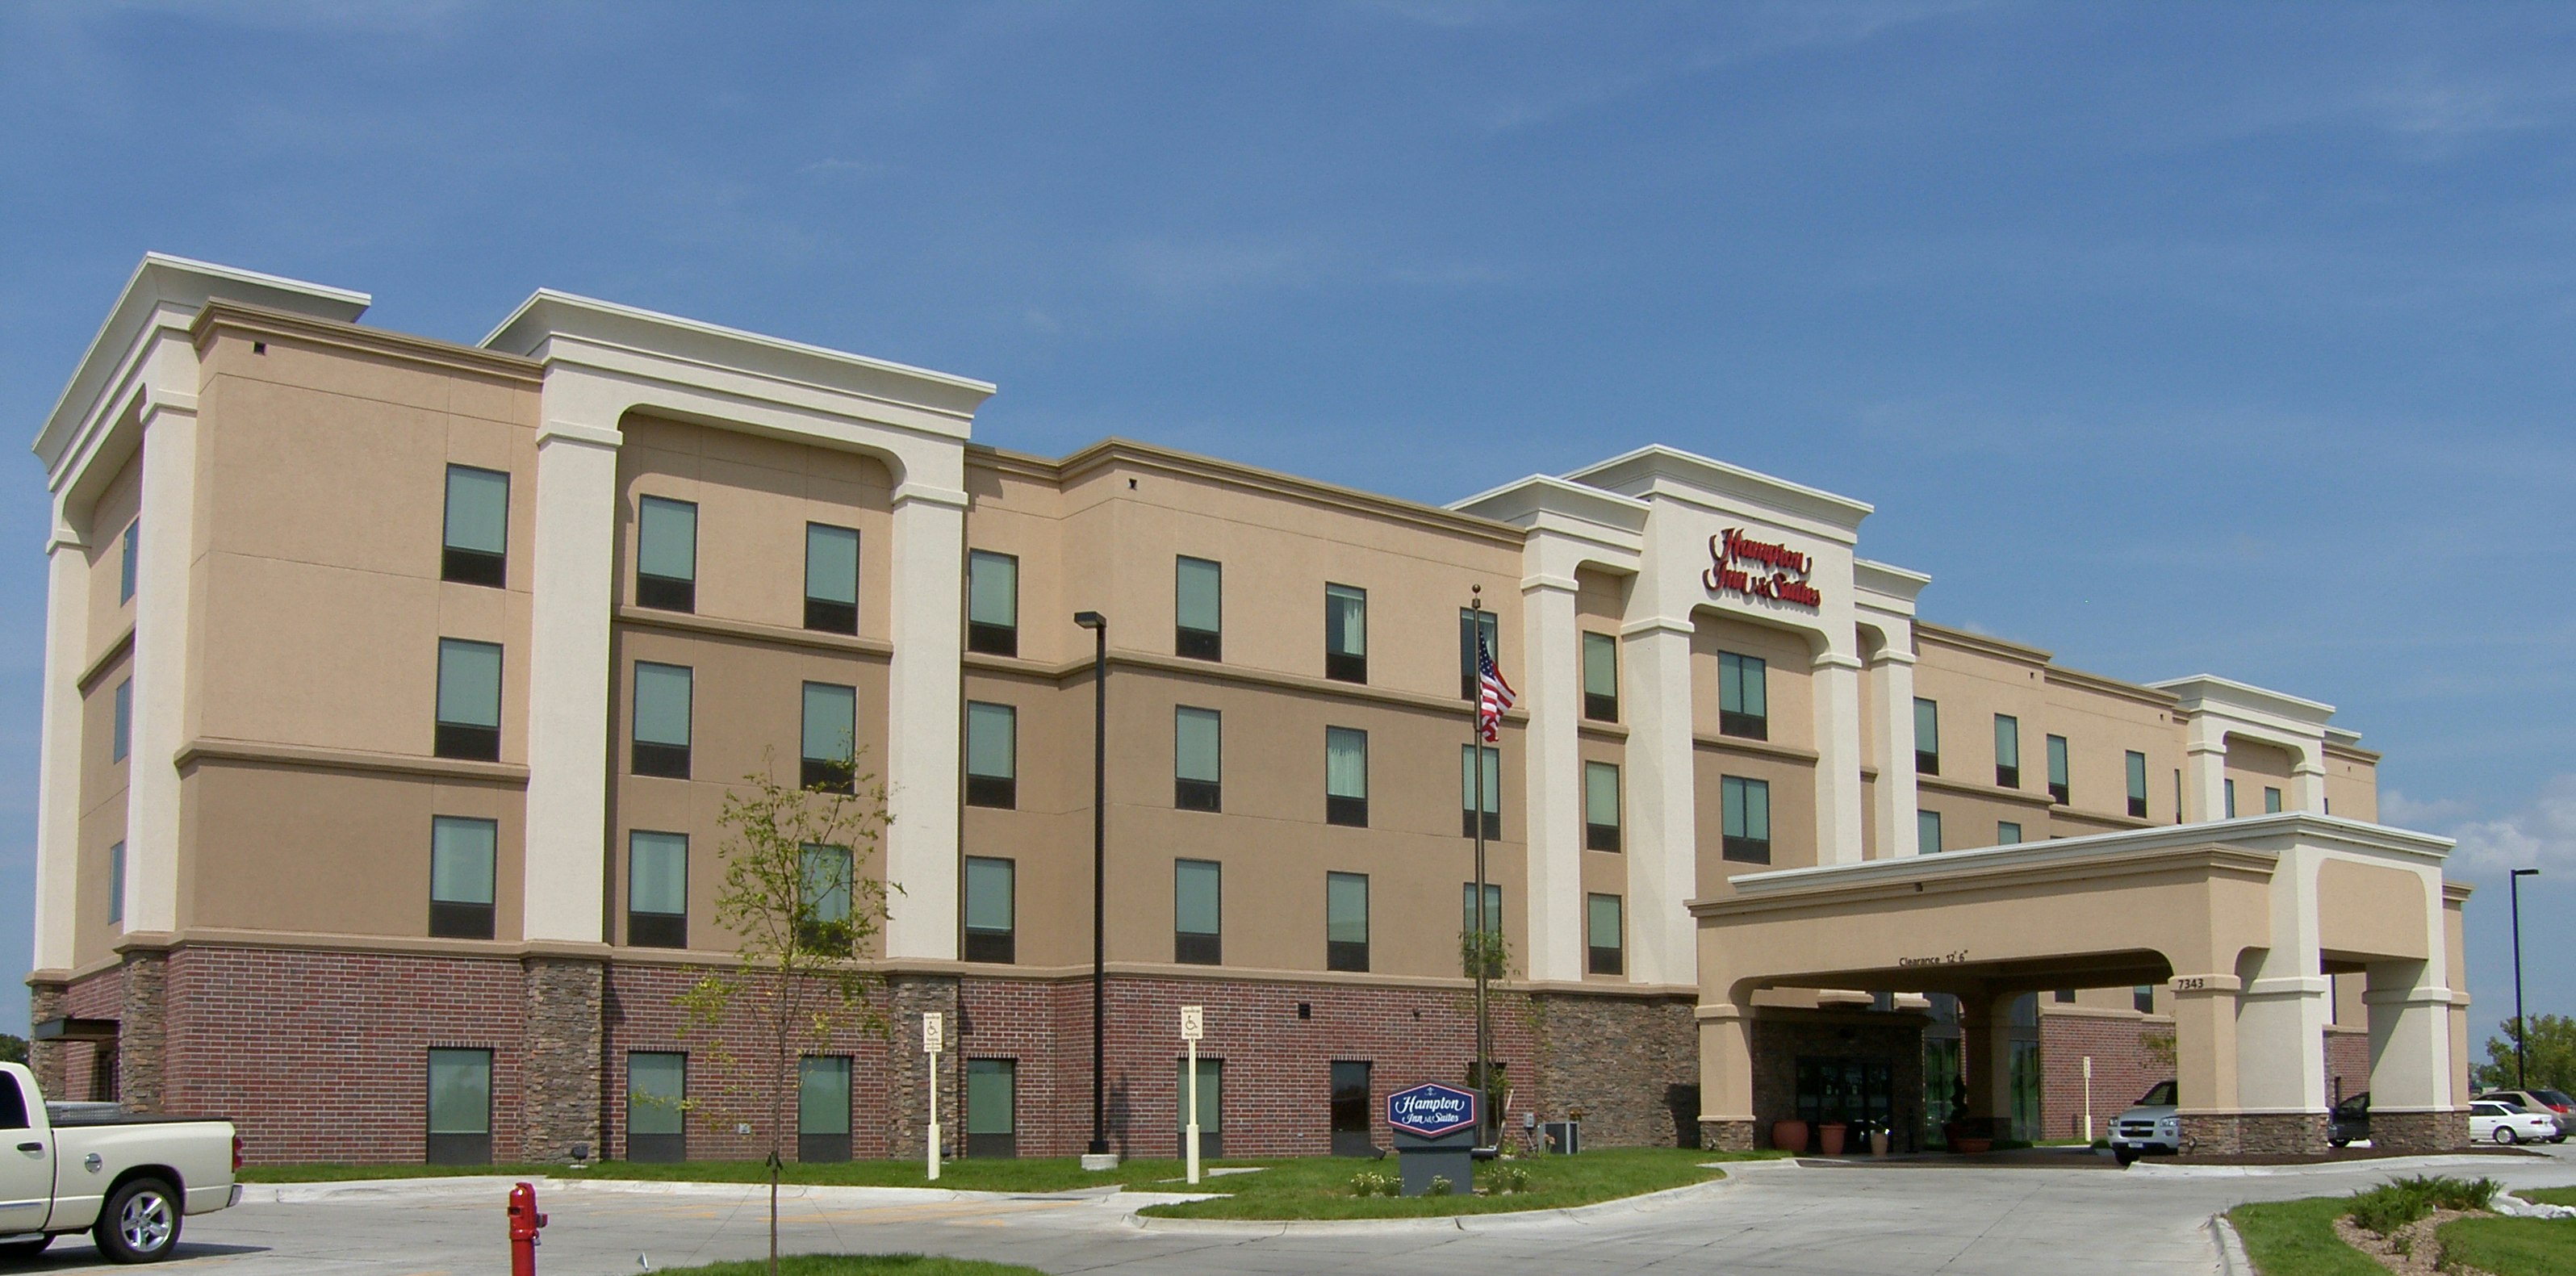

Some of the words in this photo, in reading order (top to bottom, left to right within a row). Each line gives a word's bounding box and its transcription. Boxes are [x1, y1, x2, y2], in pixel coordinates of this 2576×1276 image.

[1709, 527, 1812, 575] Hampton
[1702, 560, 1756, 595] Inn
[1767, 572, 1821, 608] Suites
[1899, 956, 1940, 967] Clearance
[2177, 977, 2204, 989] 7343
[1395, 1094, 1465, 1114] Hampton
[1401, 1113, 1427, 1124] Inn
[1432, 1112, 1459, 1123] Suites
